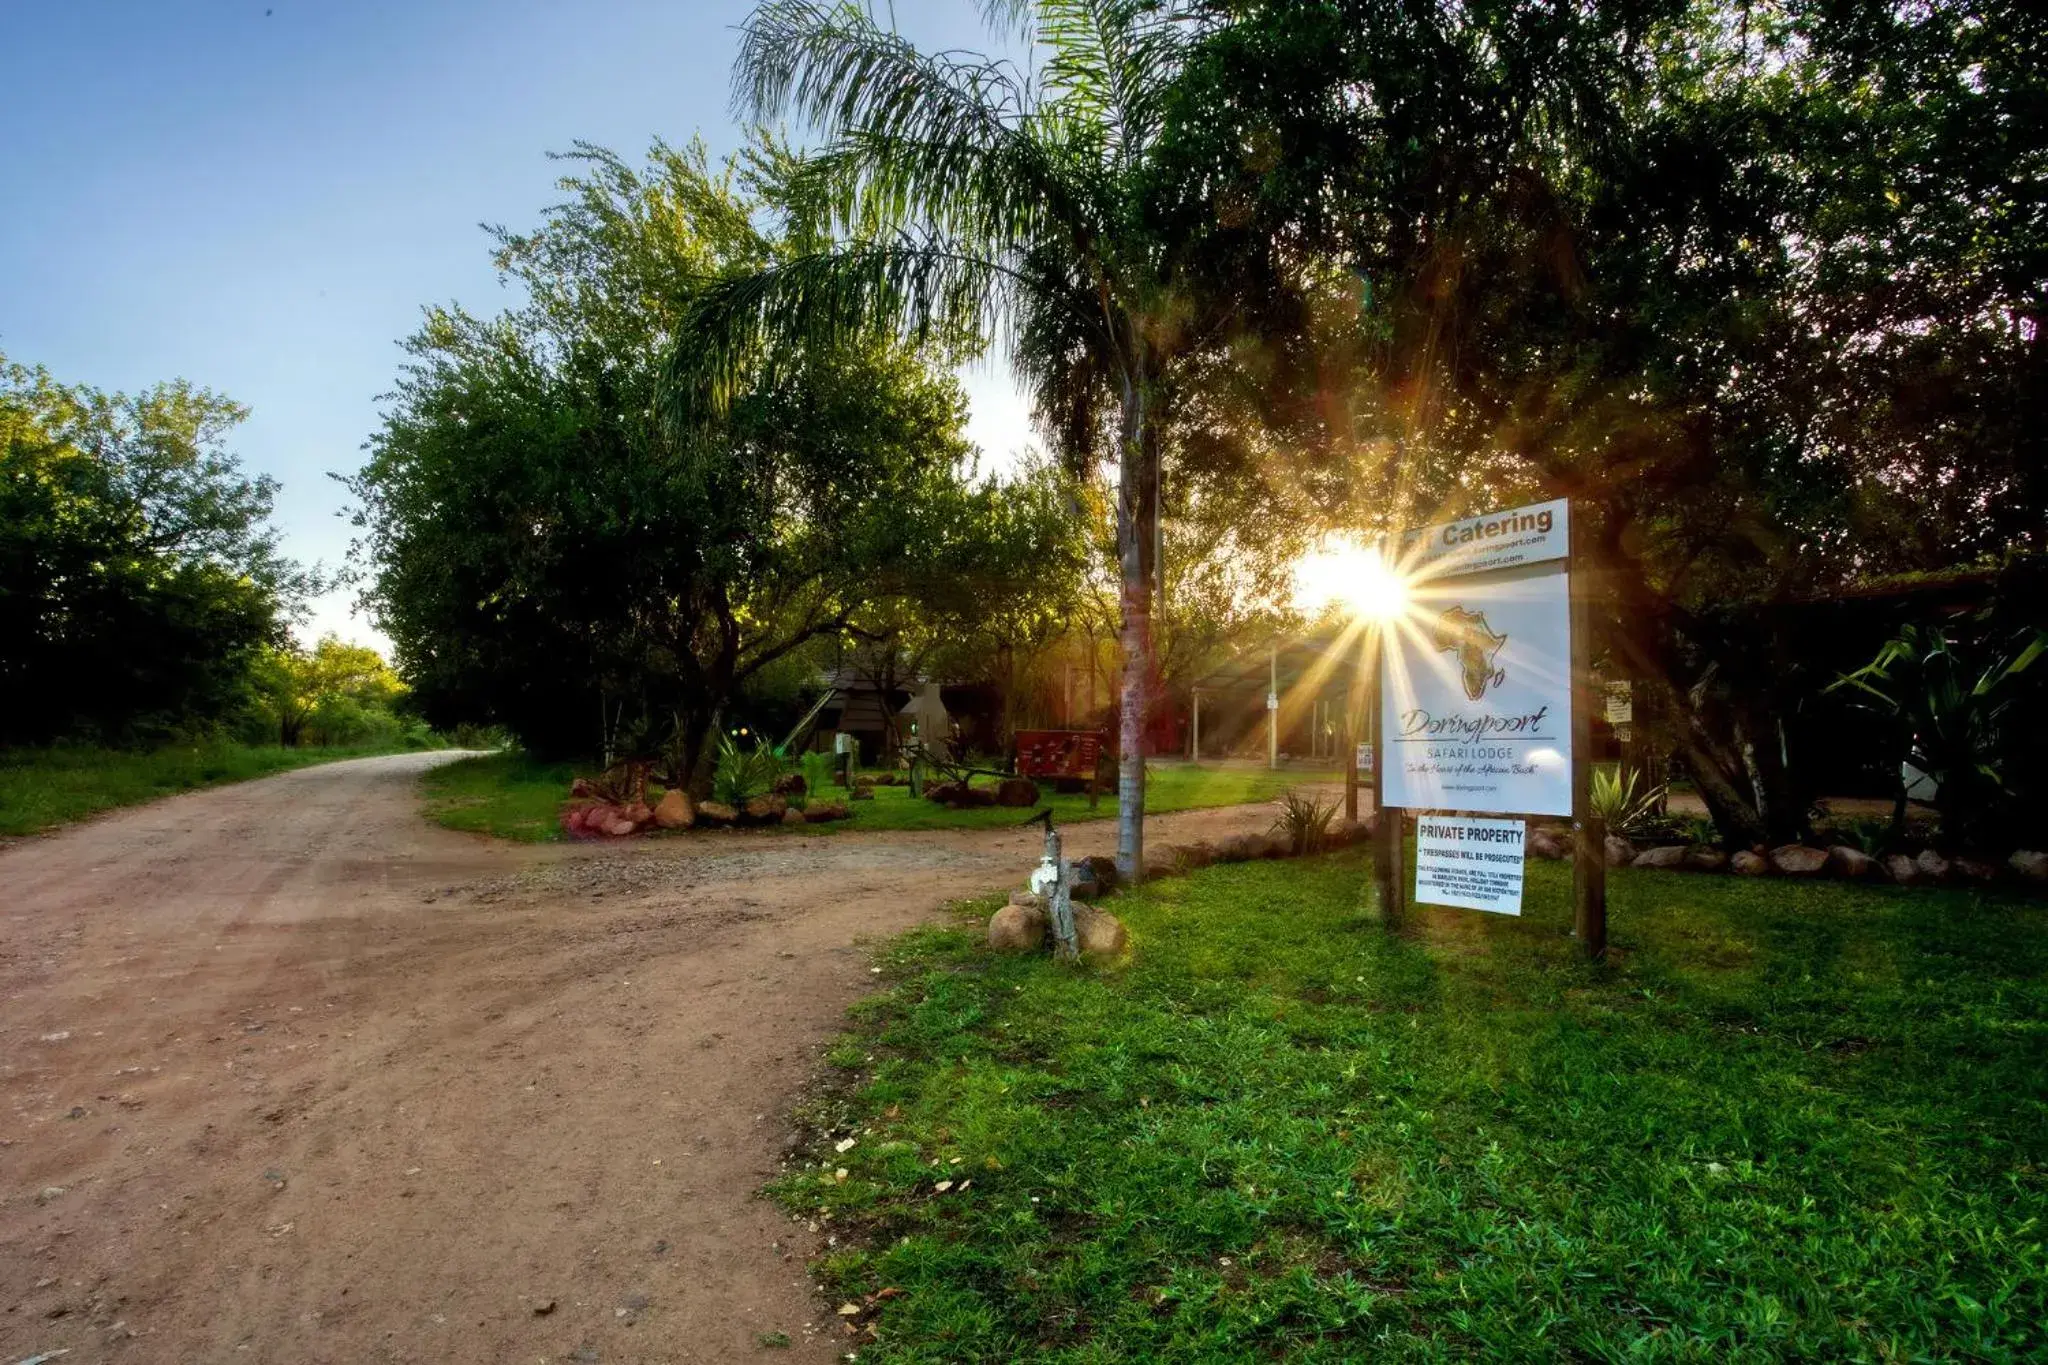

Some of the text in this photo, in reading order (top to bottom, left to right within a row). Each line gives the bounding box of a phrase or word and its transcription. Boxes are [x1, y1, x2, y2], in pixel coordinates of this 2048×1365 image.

[1442, 509, 1553, 546] Catering
[1399, 705, 1549, 744] Doringpoort
[1427, 747, 1513, 759] SAFARI LODGE
[1464, 763, 1475, 773] the
[1420, 825, 1523, 844] PRIVATE PROPERTY
[1460, 851, 1474, 860] WILL
[1475, 852, 1483, 861] BE
